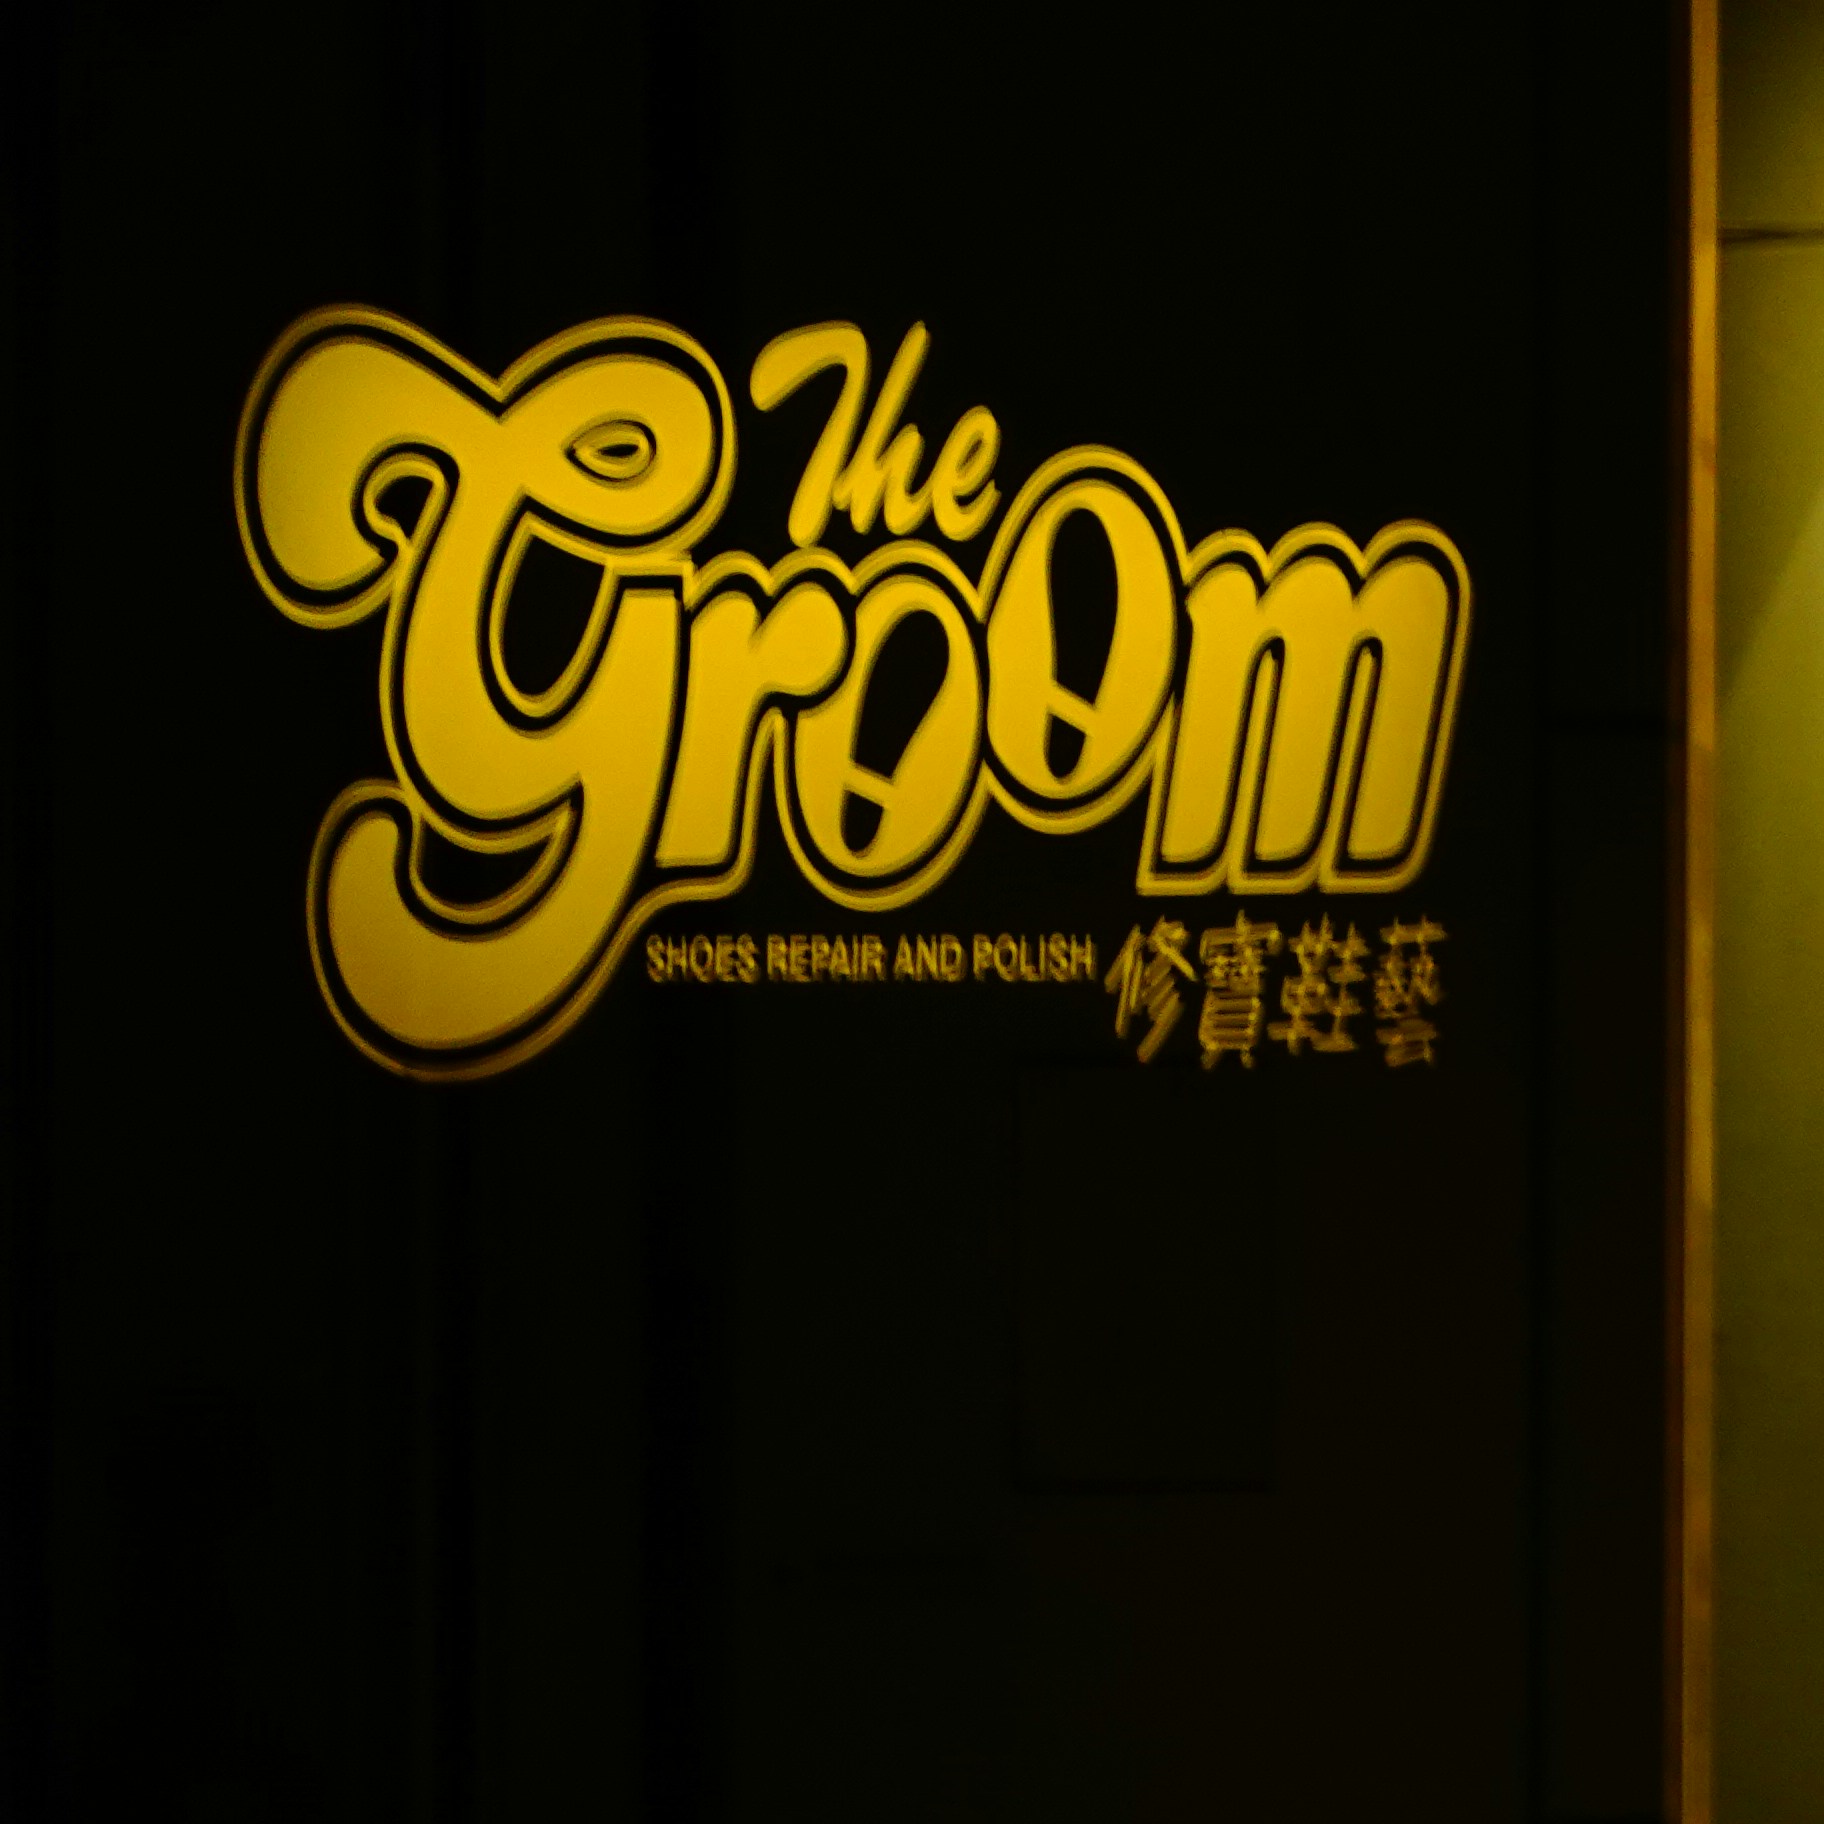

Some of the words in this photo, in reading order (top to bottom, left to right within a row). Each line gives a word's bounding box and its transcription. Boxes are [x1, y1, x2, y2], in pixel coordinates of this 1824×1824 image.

[750, 320, 1001, 548] The
[645, 932, 760, 984] SHOES
[765, 932, 888, 983] REPAIR
[893, 932, 967, 983] AND
[972, 932, 1096, 983] POLISH
